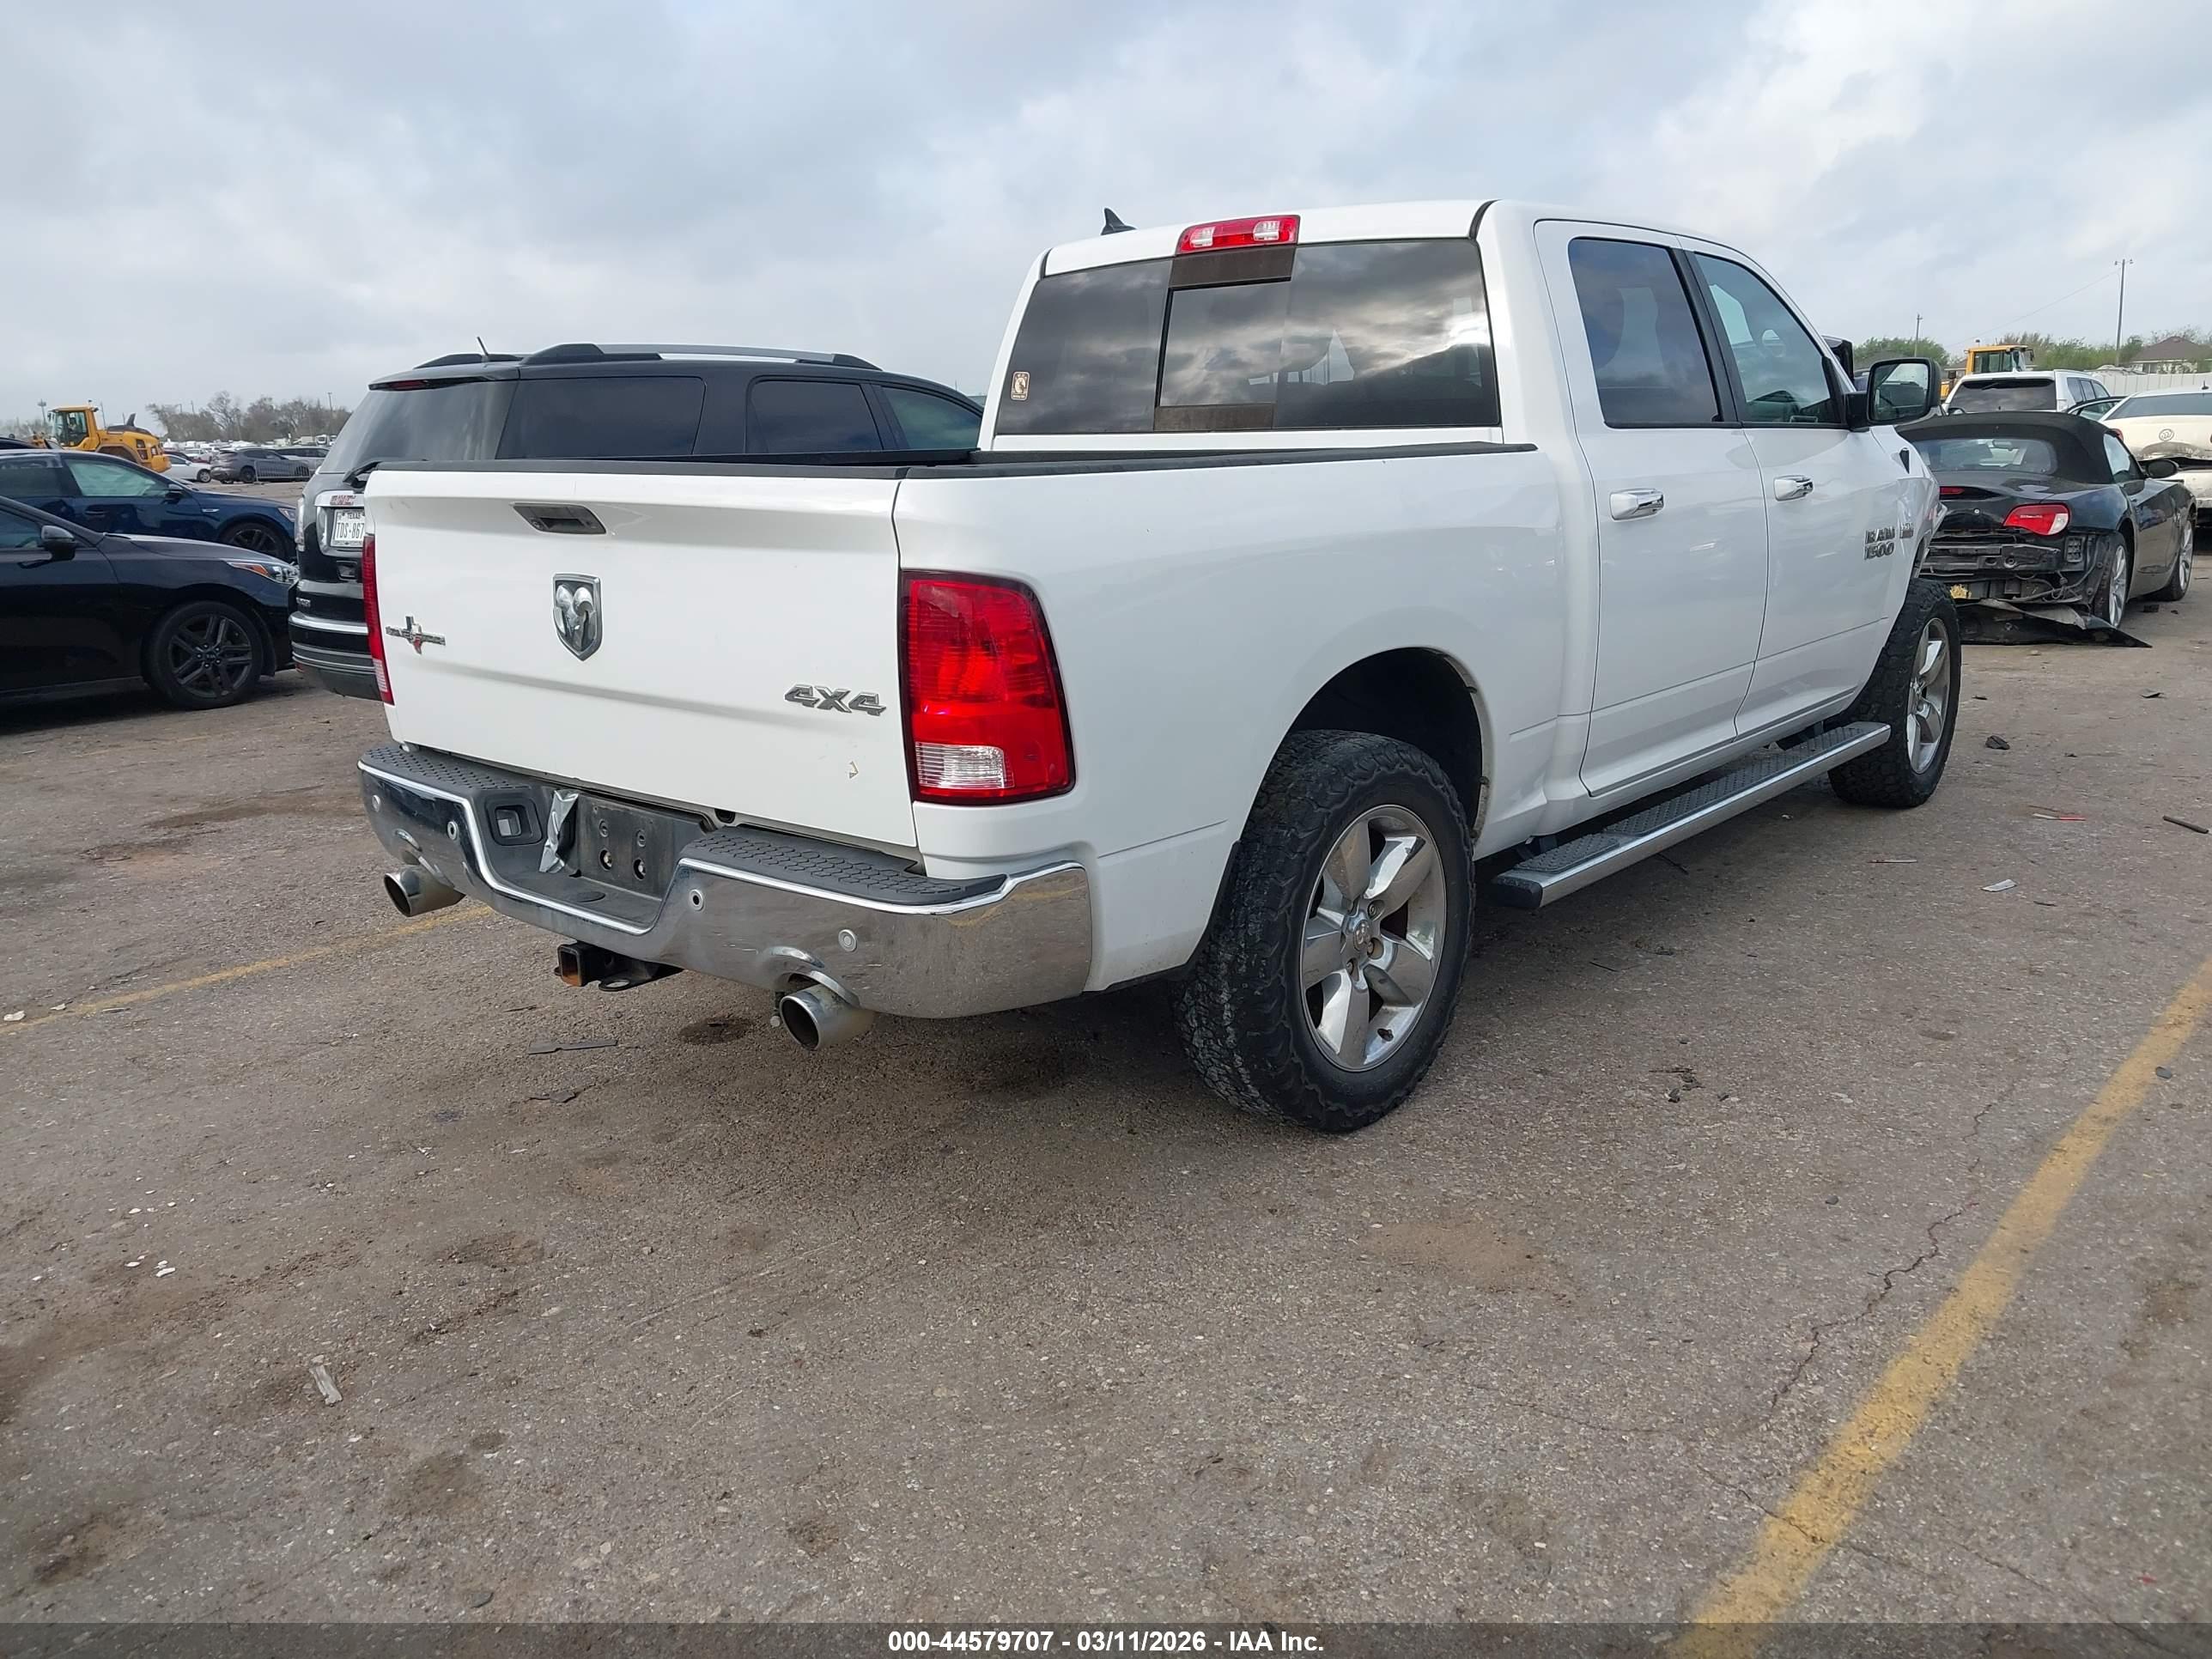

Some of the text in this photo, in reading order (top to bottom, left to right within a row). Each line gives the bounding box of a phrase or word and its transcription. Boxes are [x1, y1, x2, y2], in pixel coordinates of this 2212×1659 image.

[330, 495, 356, 506] GMC
[1865, 527, 1895, 544] RAM
[1864, 541, 1895, 560] 1500
